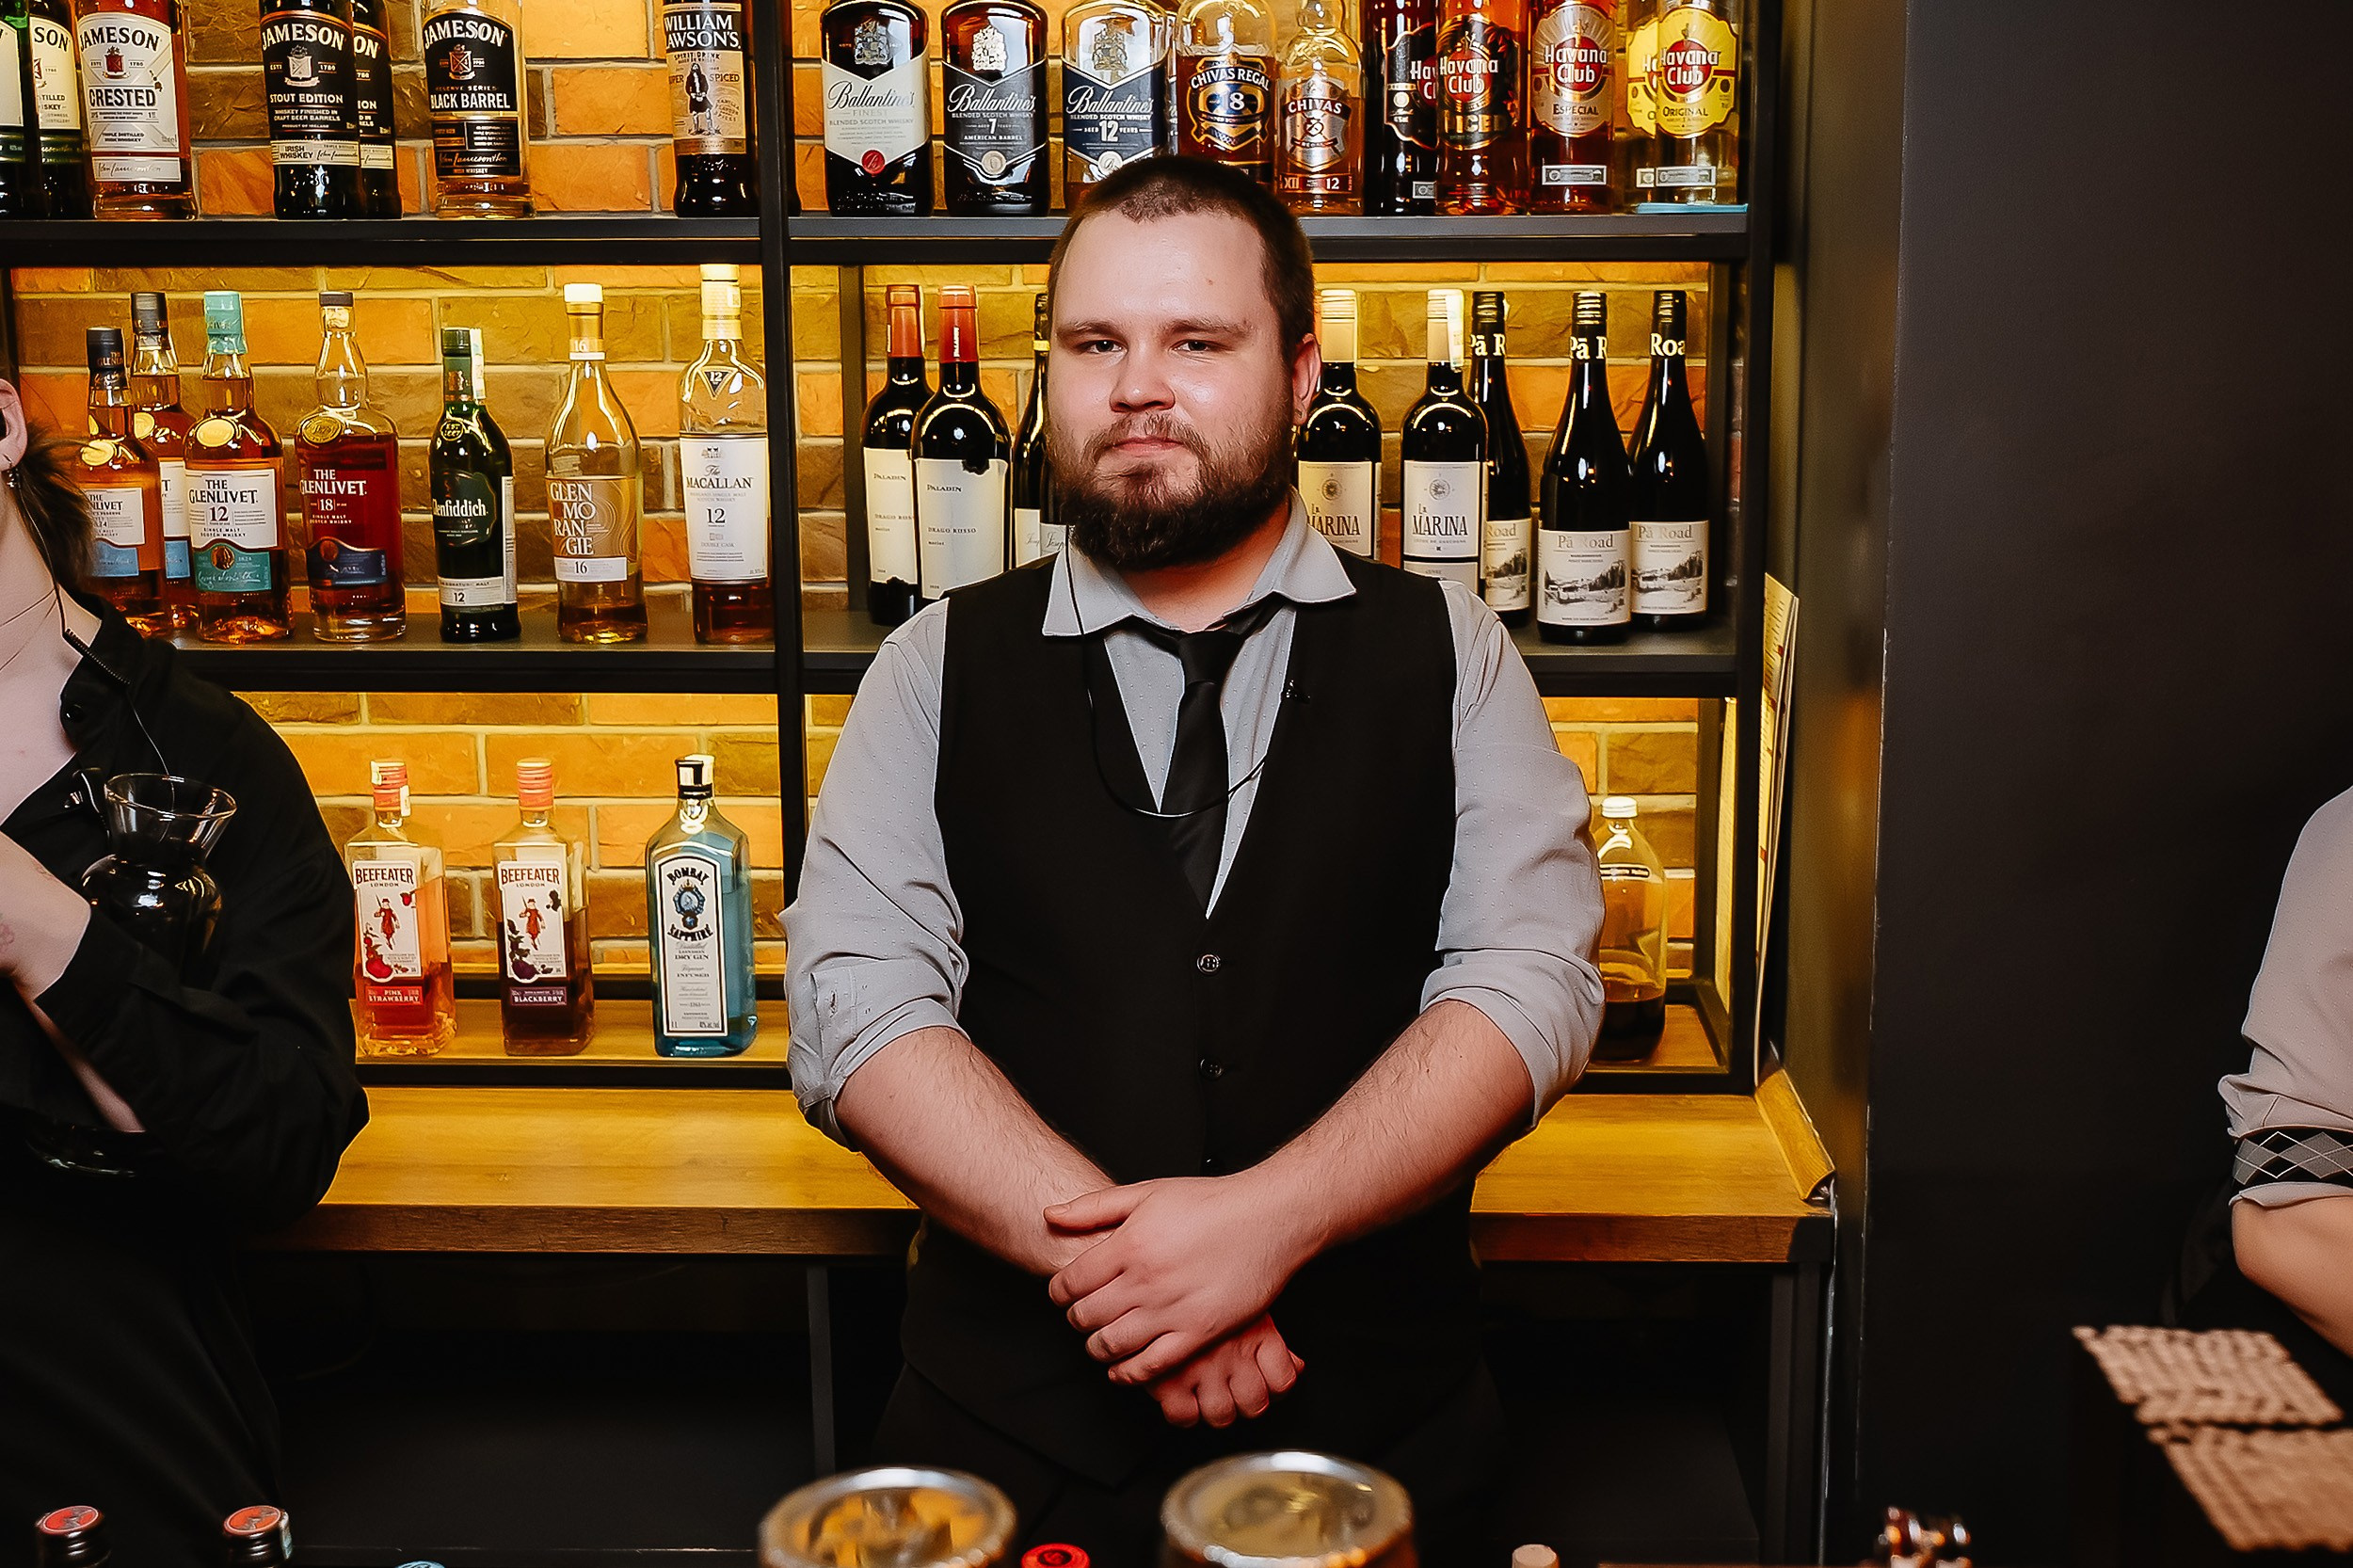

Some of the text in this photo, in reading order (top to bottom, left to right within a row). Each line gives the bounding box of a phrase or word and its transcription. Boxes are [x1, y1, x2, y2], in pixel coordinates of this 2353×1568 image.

[664, 14, 733, 32] WILLIAM
[80, 26, 159, 52] JAMESON
[262, 24, 344, 51] JAMESON
[424, 20, 505, 49] JAMESON
[674, 51, 694, 60] SPIRIT
[1545, 43, 1608, 65] Havana
[1659, 47, 1721, 67] Havana
[1439, 56, 1498, 75] Havana
[1556, 63, 1596, 84] Club
[709, 73, 740, 83] SPICED
[1191, 68, 1269, 91] CHIVAS REGAL
[1449, 74, 1485, 94] Club
[1667, 66, 1704, 86] Club
[89, 88, 156, 107] CRESTED
[270, 94, 344, 104] STOUT EDITION
[460, 92, 510, 109] BARREL
[827, 80, 915, 110] Ballantine's
[947, 83, 1036, 112] Ballantine's
[1065, 85, 1154, 114] Ballantine's
[1229, 92, 1244, 110] 8
[1288, 99, 1343, 114] CHIVAS
[988, 118, 997, 135] 7
[1098, 120, 1119, 142] 12
[1326, 177, 1339, 190] 12
[573, 339, 586, 352] 16
[710, 372, 723, 382] 12
[313, 469, 336, 480] THE
[705, 464, 721, 477] The
[873, 472, 906, 481] PALADIN
[205, 479, 227, 489] THE
[686, 476, 752, 489] MACALLAN
[927, 484, 962, 492] PALADIN
[551, 482, 593, 502] GLEN
[320, 498, 333, 511] 18
[562, 501, 597, 520] MO
[210, 506, 229, 521] 12
[707, 508, 726, 524] 12
[553, 519, 584, 536] RAN
[1413, 515, 1468, 536] MARINA
[1660, 524, 1692, 538] Road
[566, 536, 594, 555] GIE
[1582, 534, 1614, 548] Road
[575, 561, 588, 574] 16
[454, 592, 465, 602] 12
[355, 868, 414, 885] BEEFEATER
[501, 868, 560, 885] BEEFEATER
[666, 867, 710, 886] BOMBAY
[667, 923, 713, 942] SAPPHIRE
